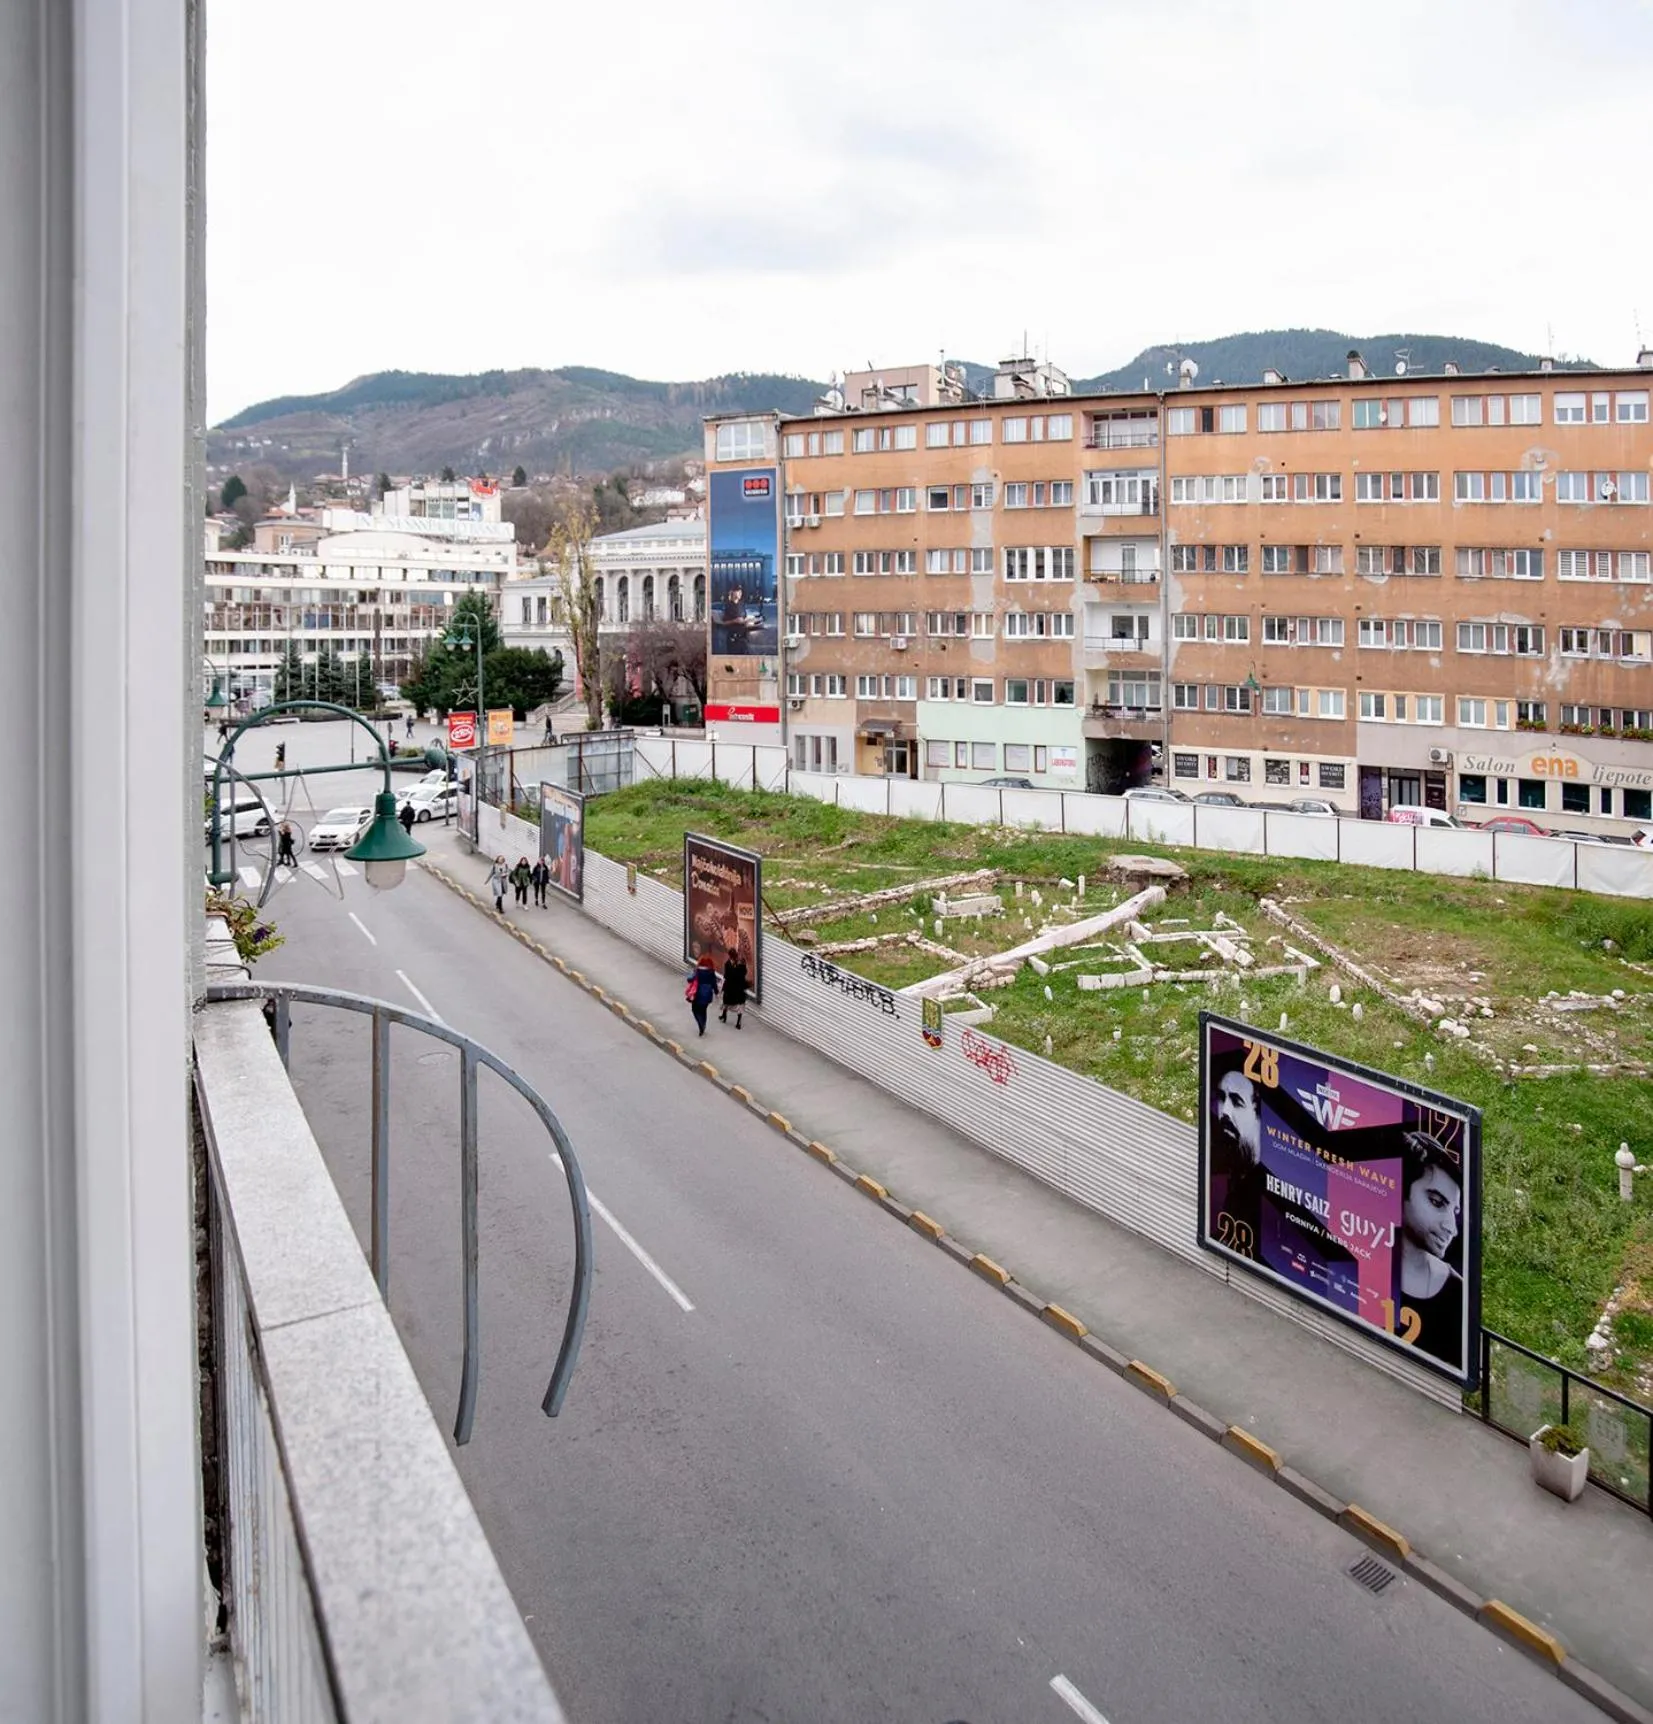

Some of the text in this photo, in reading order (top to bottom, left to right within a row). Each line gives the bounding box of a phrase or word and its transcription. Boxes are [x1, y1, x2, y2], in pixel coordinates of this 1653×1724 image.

[1464, 755, 1579, 778] Salon ena
[1243, 1040, 1279, 1088] 28
[1266, 1126, 1396, 1190] WINTER FRESH WAVE
[1266, 1174, 1330, 1218] HENRY SAIZ
[1285, 1212, 1320, 1236] FORNIVA
[1381, 1298, 1421, 1345] 12
